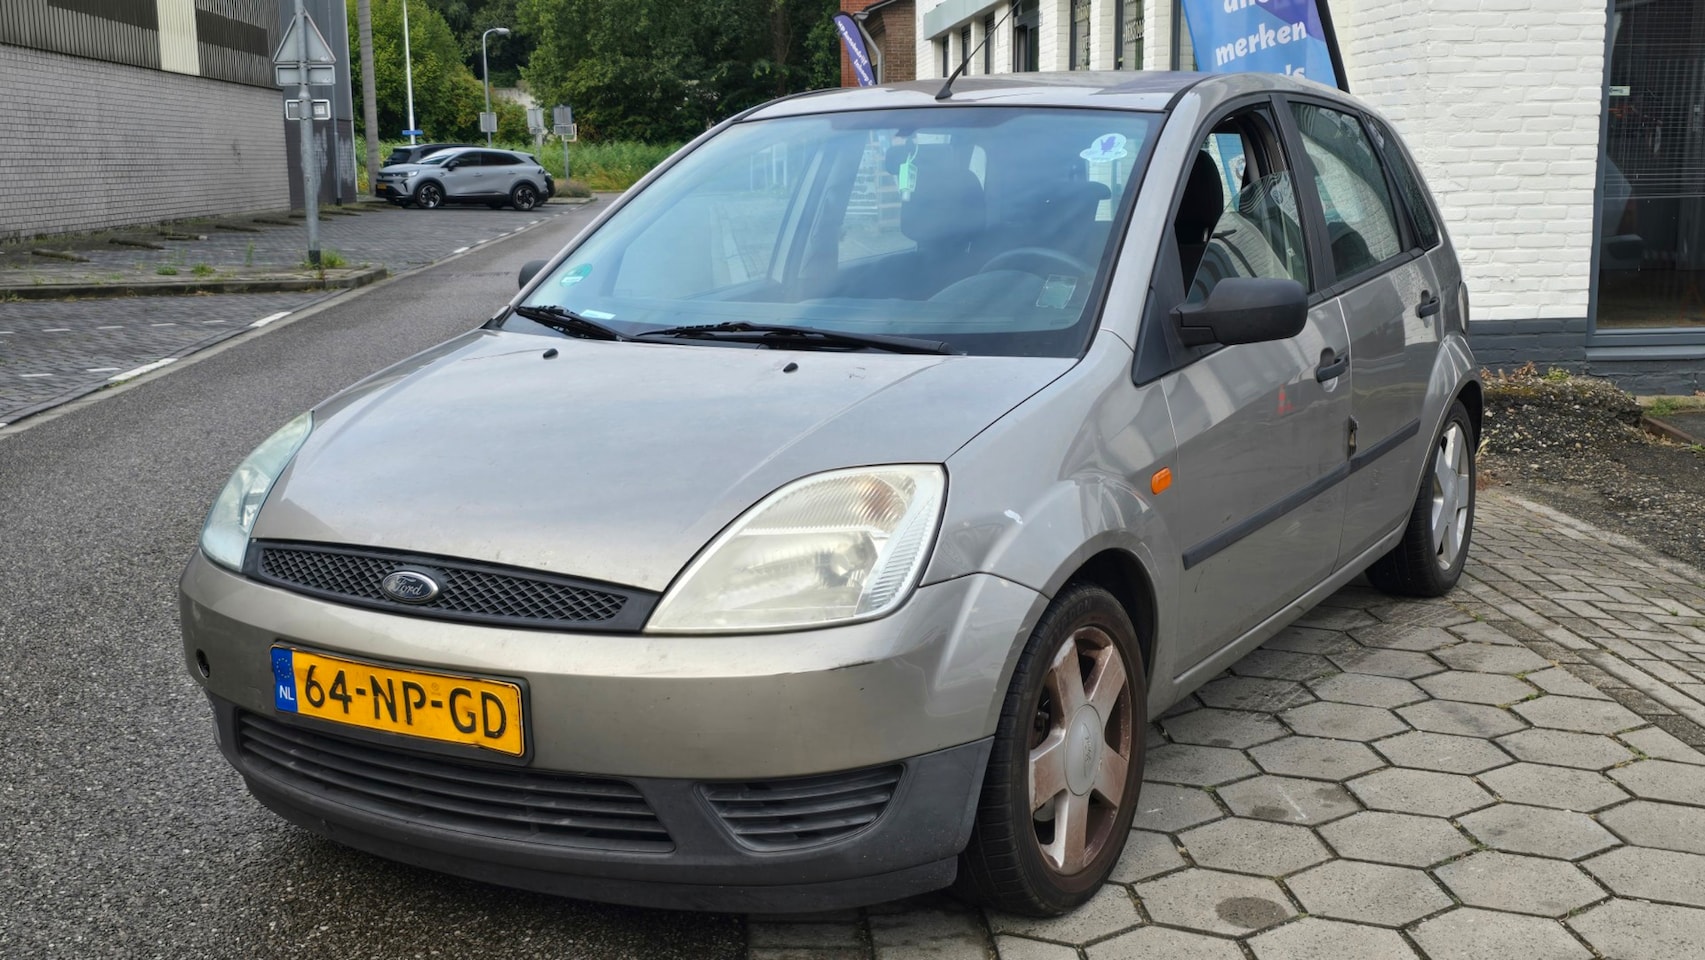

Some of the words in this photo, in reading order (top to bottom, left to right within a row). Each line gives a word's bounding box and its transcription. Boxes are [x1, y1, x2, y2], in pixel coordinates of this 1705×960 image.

[1215, 21, 1307, 66] merken
[393, 575, 423, 596] Ford
[279, 685, 295, 701] NL
[304, 664, 507, 739] 64-NP-GD
